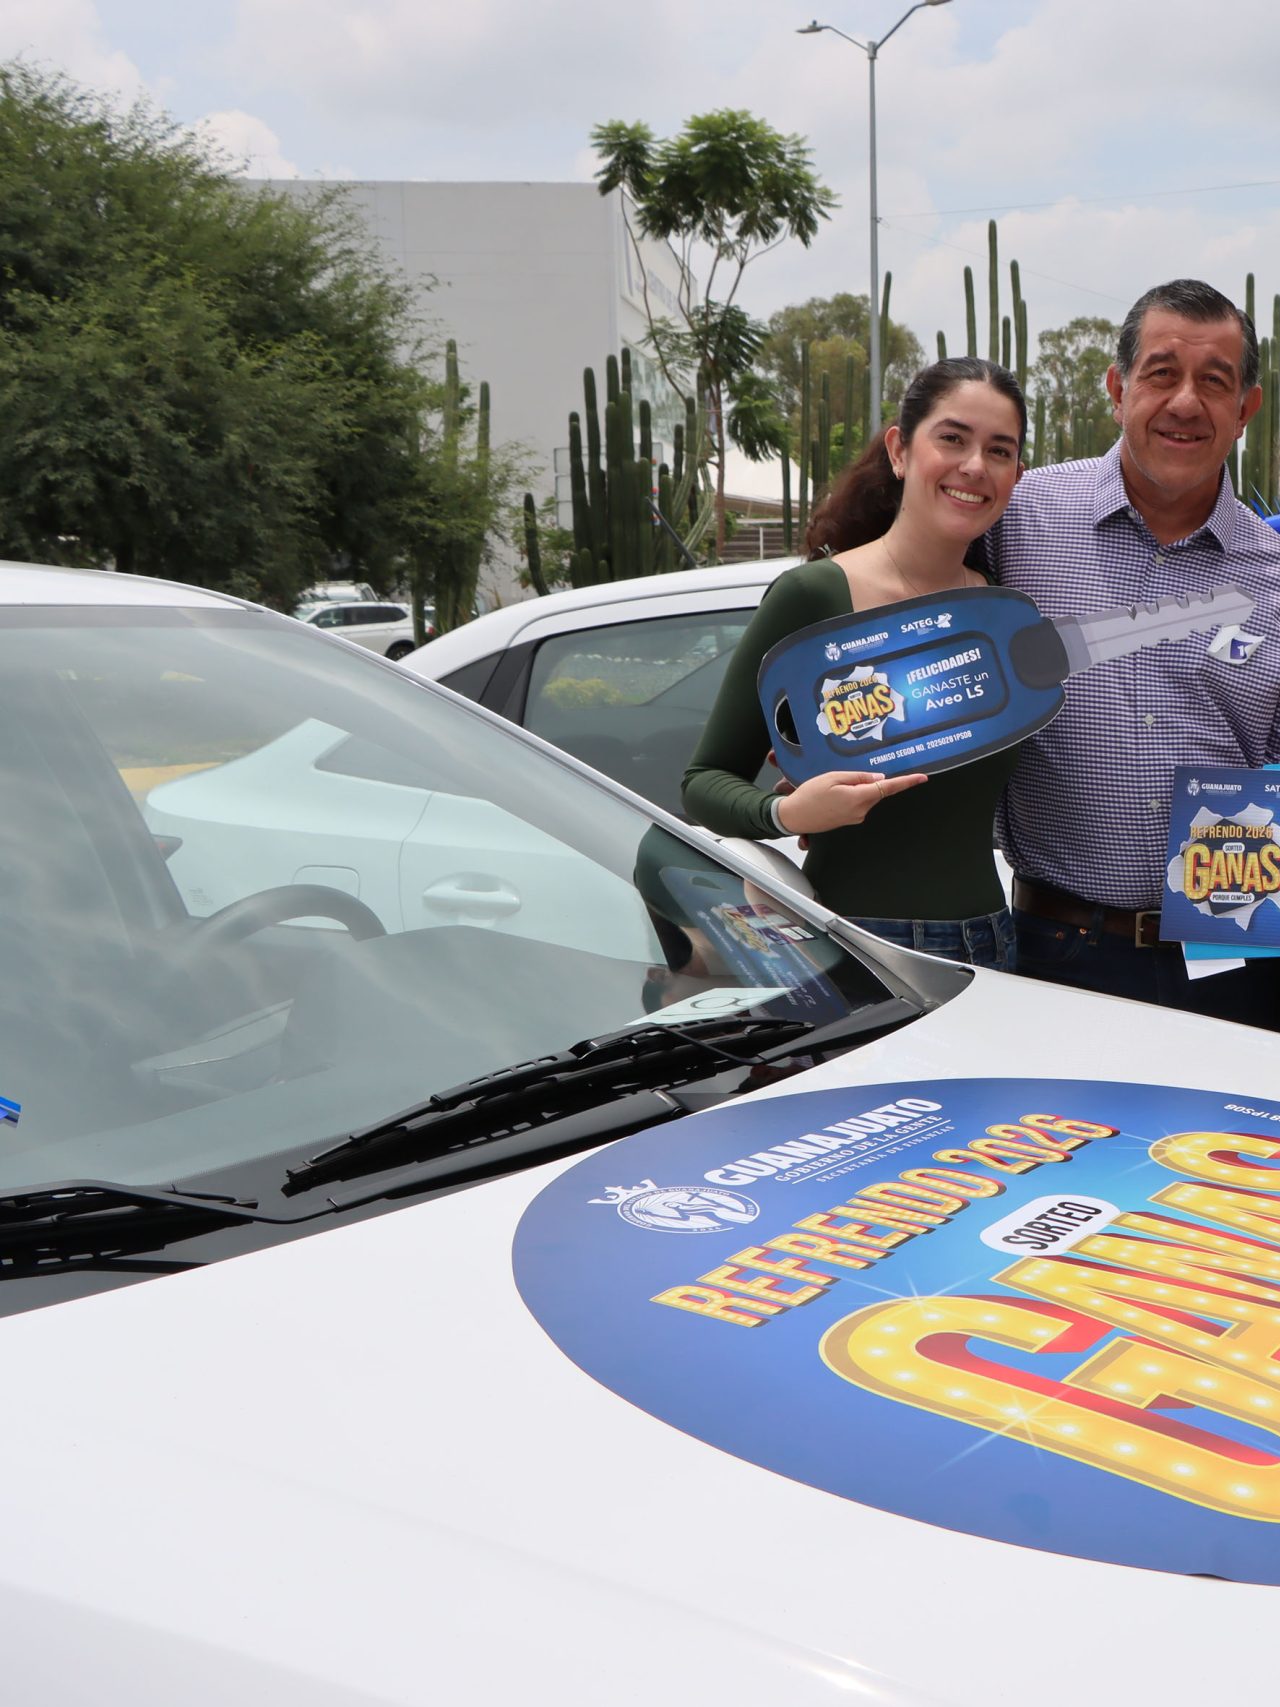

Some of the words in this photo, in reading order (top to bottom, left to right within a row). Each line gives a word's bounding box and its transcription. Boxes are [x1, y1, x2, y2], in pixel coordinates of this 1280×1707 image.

[841, 632, 888, 650] GUANAJUATO
[901, 618, 933, 633] SATEG
[906, 648, 982, 685] ¡FELICIDADES!
[912, 674, 972, 698] GANASTE
[974, 672, 989, 682] un
[926, 694, 962, 712] Aveo
[966, 684, 984, 698] LS
[825, 685, 896, 736] GANAS
[870, 752, 896, 766] PERMISO
[896, 746, 916, 758] SEGOB
[1202, 783, 1242, 792] GUANAJUATO
[1190, 825, 1242, 838] REFRENDO
[1246, 824, 1273, 838] 2026
[704, 1098, 943, 1186] GUANAJUATO
[774, 1147, 855, 1182] GOBIERNO
[858, 1138, 879, 1151] DE
[878, 1132, 898, 1144] LA
[894, 1115, 943, 1135] GENTE
[816, 1152, 888, 1183] SECRETARÍA
[887, 1144, 904, 1155] DE
[902, 1126, 955, 1148] FINANZAS
[649, 1166, 1008, 1328] REFRENDO
[932, 1112, 1121, 1175] 2026
[1001, 1201, 1102, 1252] SORTEO
